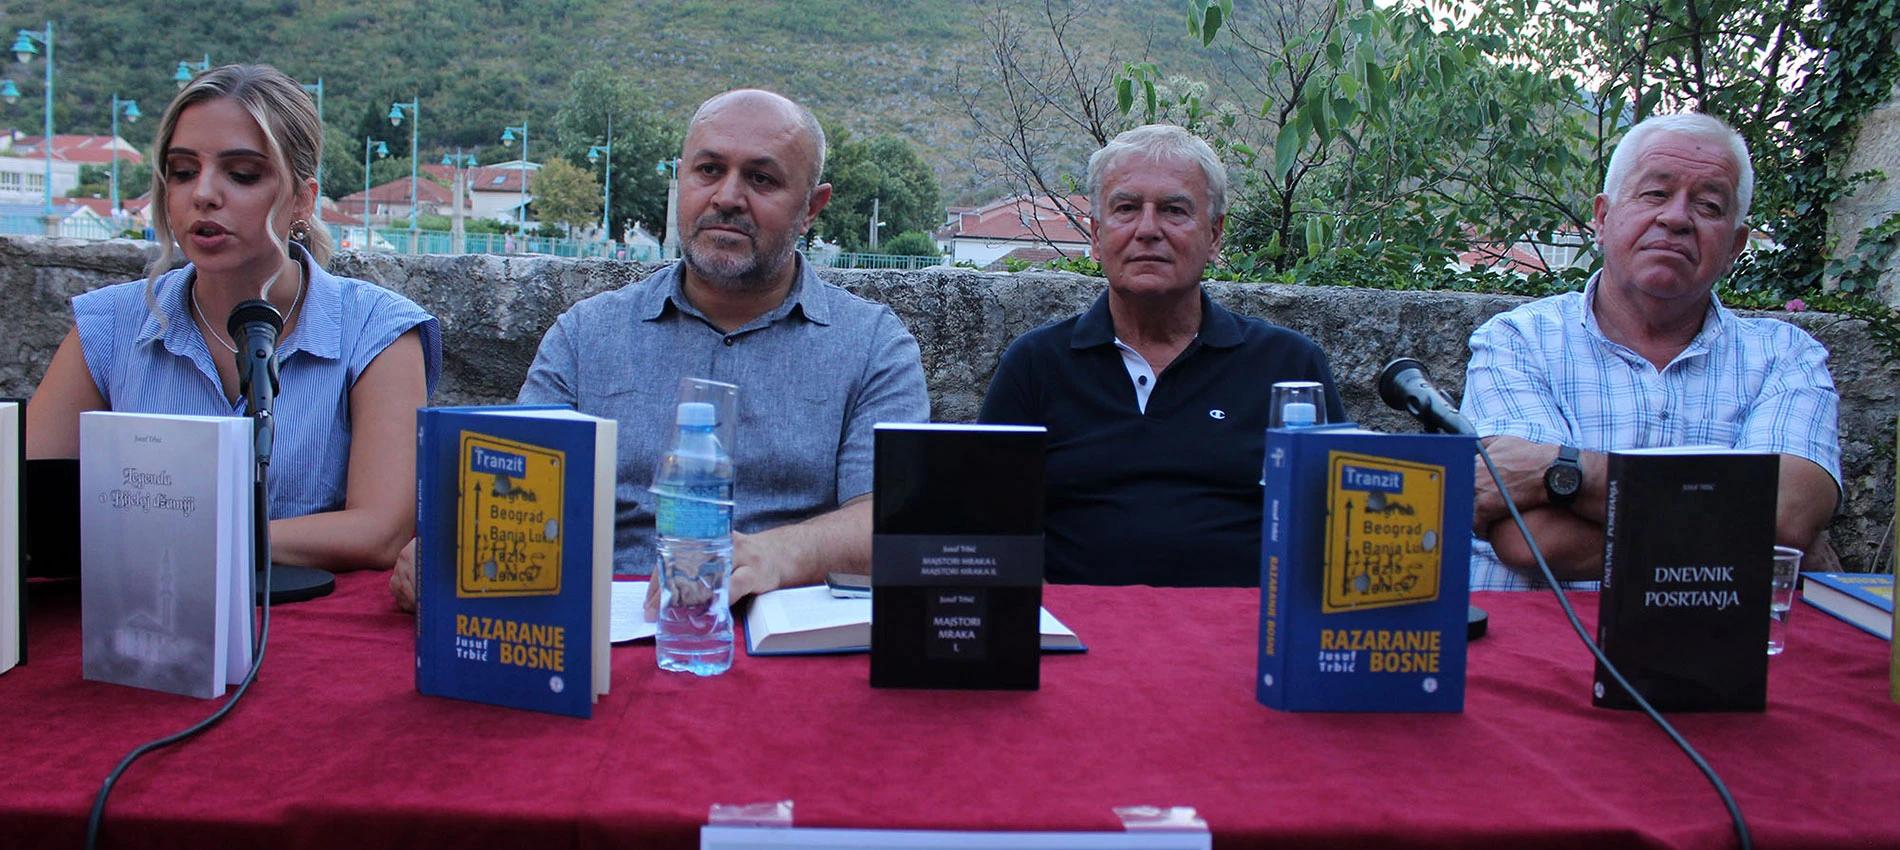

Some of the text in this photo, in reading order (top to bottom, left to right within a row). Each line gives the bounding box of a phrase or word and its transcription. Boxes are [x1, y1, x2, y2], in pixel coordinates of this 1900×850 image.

[475, 447, 524, 473] Tranzit
[122, 467, 172, 489] Legenda
[1346, 467, 1401, 489] Tranzit
[490, 504, 543, 525] Beograd
[490, 526, 526, 544] Banja
[1364, 520, 1422, 538] Beograd
[1603, 480, 1618, 588] DNEVNIK POSRTANJA
[1363, 541, 1402, 557] Banja
[922, 557, 960, 566] MAJSTORI
[961, 557, 991, 566] MRAKA
[921, 567, 959, 576] MAJSTORI
[960, 567, 990, 576] MRAKA
[1654, 566, 1735, 583] DNEVNIK
[1265, 556, 1279, 656] RAZARANJE BOSNE
[1644, 590, 1741, 610] POSRTANJA
[933, 616, 981, 627] MAJSTORI
[456, 614, 565, 648] RAZARANJE
[938, 629, 976, 640] MRAKA
[1321, 629, 1441, 651] RAZARANJE
[456, 636, 488, 650] Jusuf
[456, 648, 487, 661] Trbić
[500, 642, 565, 672] BOSNE
[1318, 651, 1356, 661] Jusuf
[1369, 652, 1440, 673] BOSNE
[1319, 661, 1355, 673] Trbić
